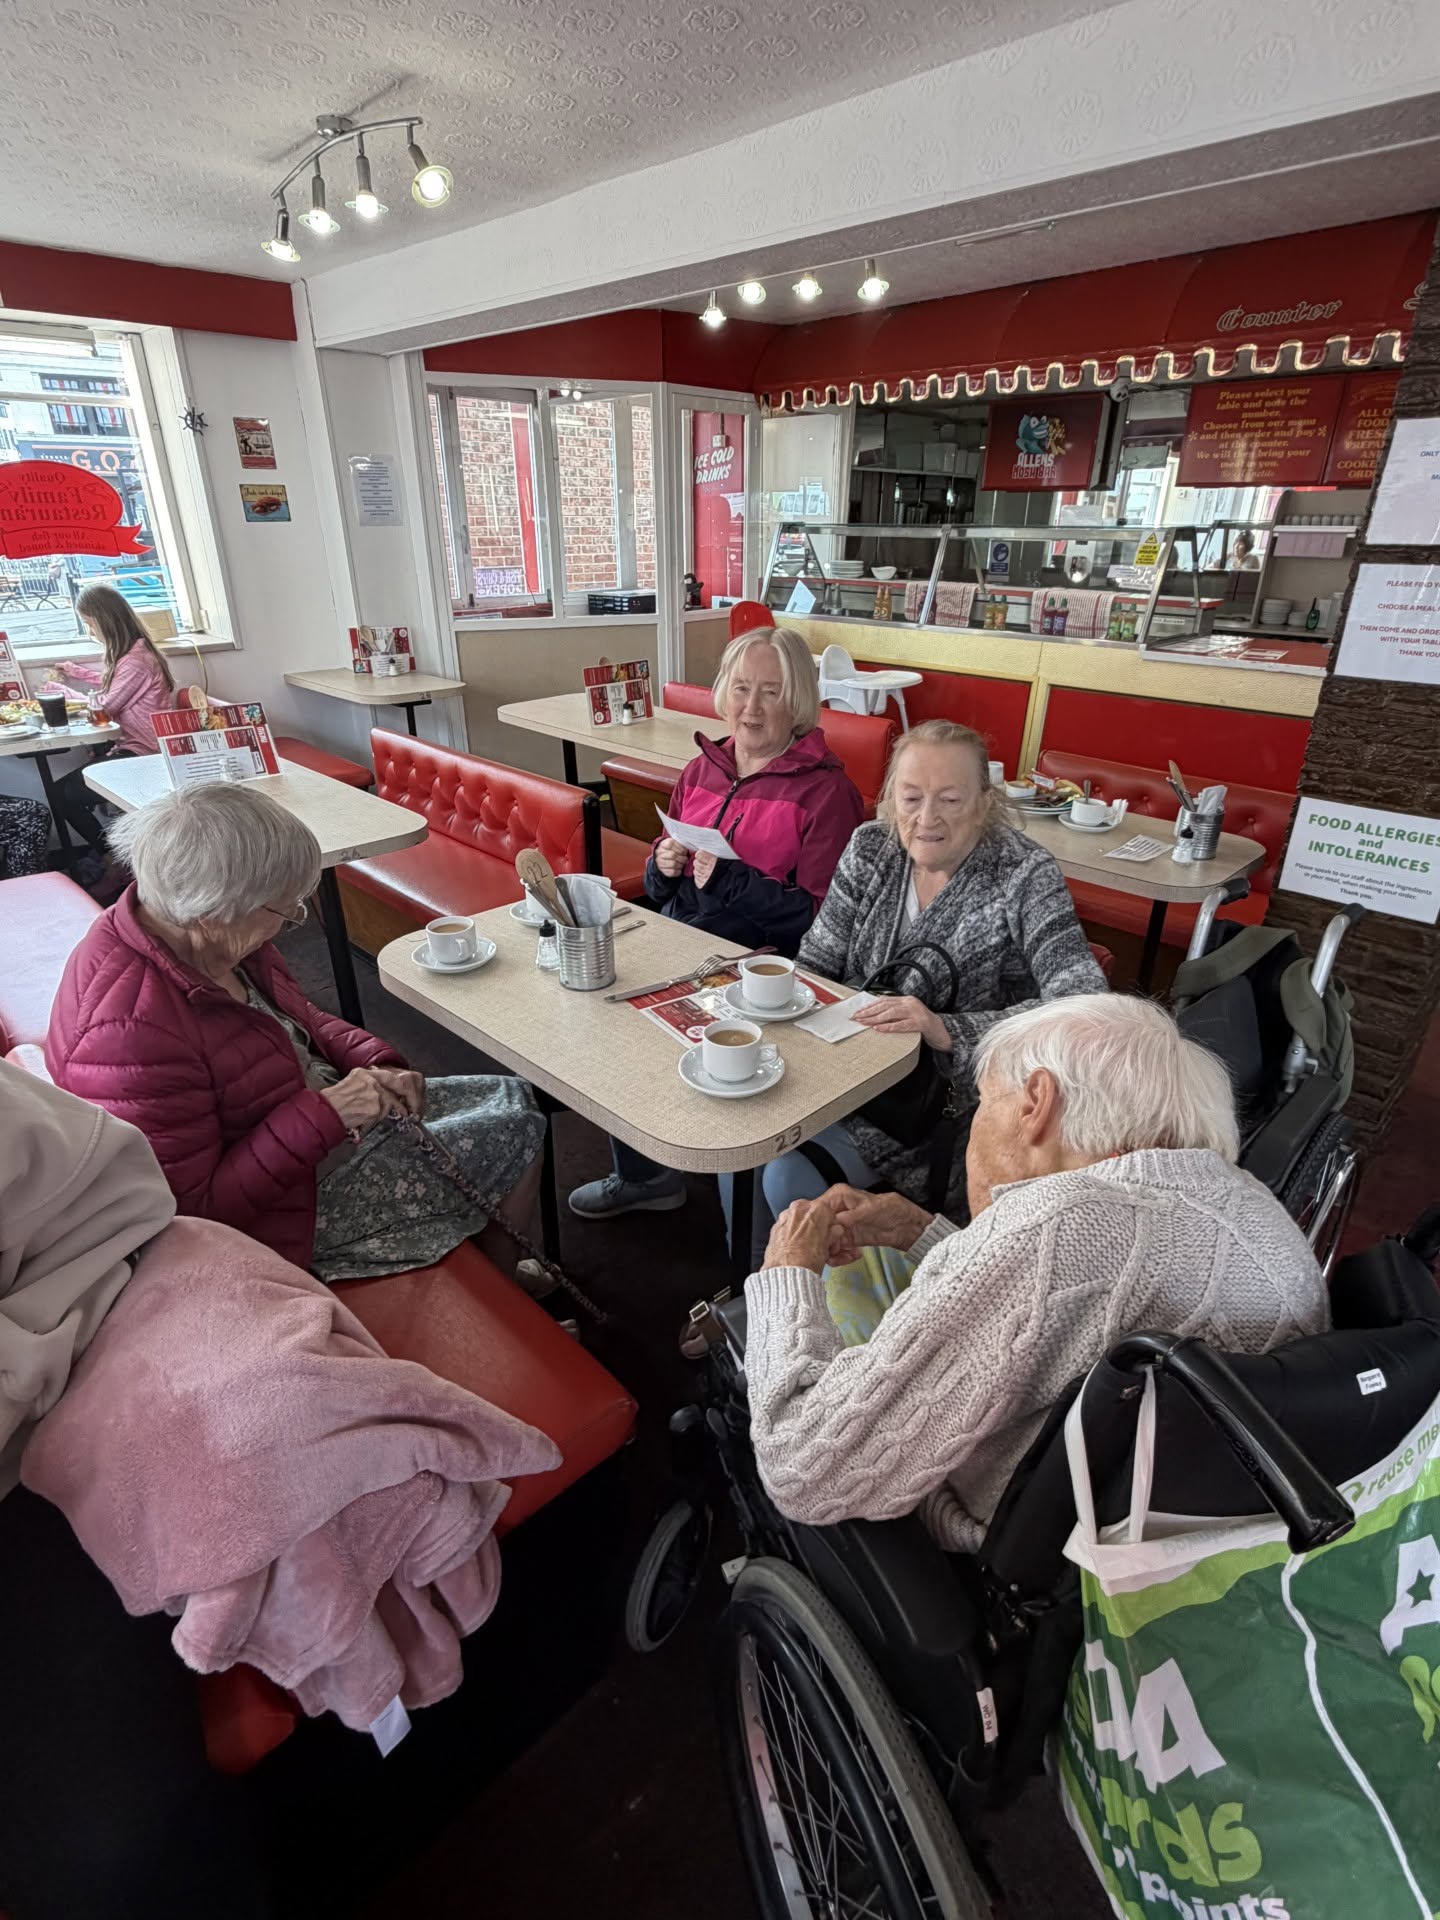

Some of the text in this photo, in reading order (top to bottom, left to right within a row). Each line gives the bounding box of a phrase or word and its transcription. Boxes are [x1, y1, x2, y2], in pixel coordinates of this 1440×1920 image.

[1216, 300, 1343, 332] Counter
[1220, 388, 1312, 400] Please select your
[1216, 397, 1307, 410] table and note the
[1241, 409, 1281, 418] number.
[1358, 408, 1379, 418] ALL
[1203, 421, 1238, 430] Choose
[1241, 420, 1265, 429] from
[1267, 420, 1285, 428] our
[1200, 427, 1316, 440] and then order and pay
[1219, 441, 1228, 449] at
[694, 446, 734, 470] ICE COLD
[1017, 452, 1055, 467] ALLENS
[1196, 450, 1210, 459] We
[1212, 450, 1231, 459] will
[1257, 448, 1285, 458] bring
[1287, 448, 1312, 457] your
[1337, 460, 1377, 469] COOKE
[696, 464, 732, 484] DRINKS
[1386, 580, 1413, 588] PLEASE
[1399, 649, 1424, 657] THANK
[1308, 814, 1440, 848] FOOD ALLERGIES
[1358, 838, 1384, 849] and
[1308, 840, 1431, 874] INTOLERANCES
[1295, 862, 1314, 871] Please
[1314, 866, 1332, 875] speak
[1351, 873, 1365, 881] staff
[1366, 876, 1383, 886] about
[1384, 879, 1396, 888] the
[1396, 882, 1432, 895] ingredients
[1311, 873, 1324, 881] your
[1359, 882, 1382, 893] making
[1382, 888, 1397, 896] your
[1397, 890, 1417, 900] order.
[1340, 888, 1374, 900] Thank you.
[1367, 1447, 1414, 1495] reuse
